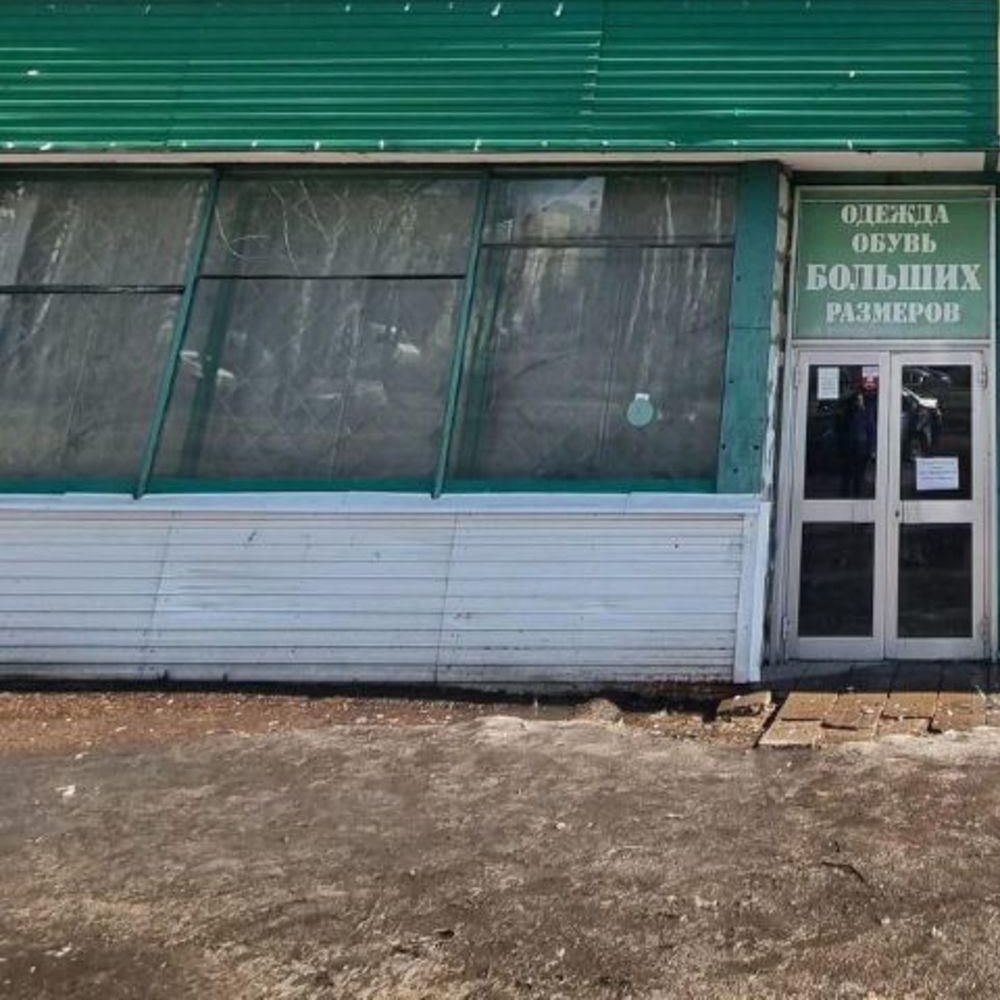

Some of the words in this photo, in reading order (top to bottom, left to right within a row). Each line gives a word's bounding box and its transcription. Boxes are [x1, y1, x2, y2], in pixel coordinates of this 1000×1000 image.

[841, 204, 950, 227] ОДЕЖДА
[852, 232, 937, 253] ОБУВЬ
[806, 263, 982, 291] БОЛЬШИХ
[825, 301, 961, 324] РАЗМЕРОВ
